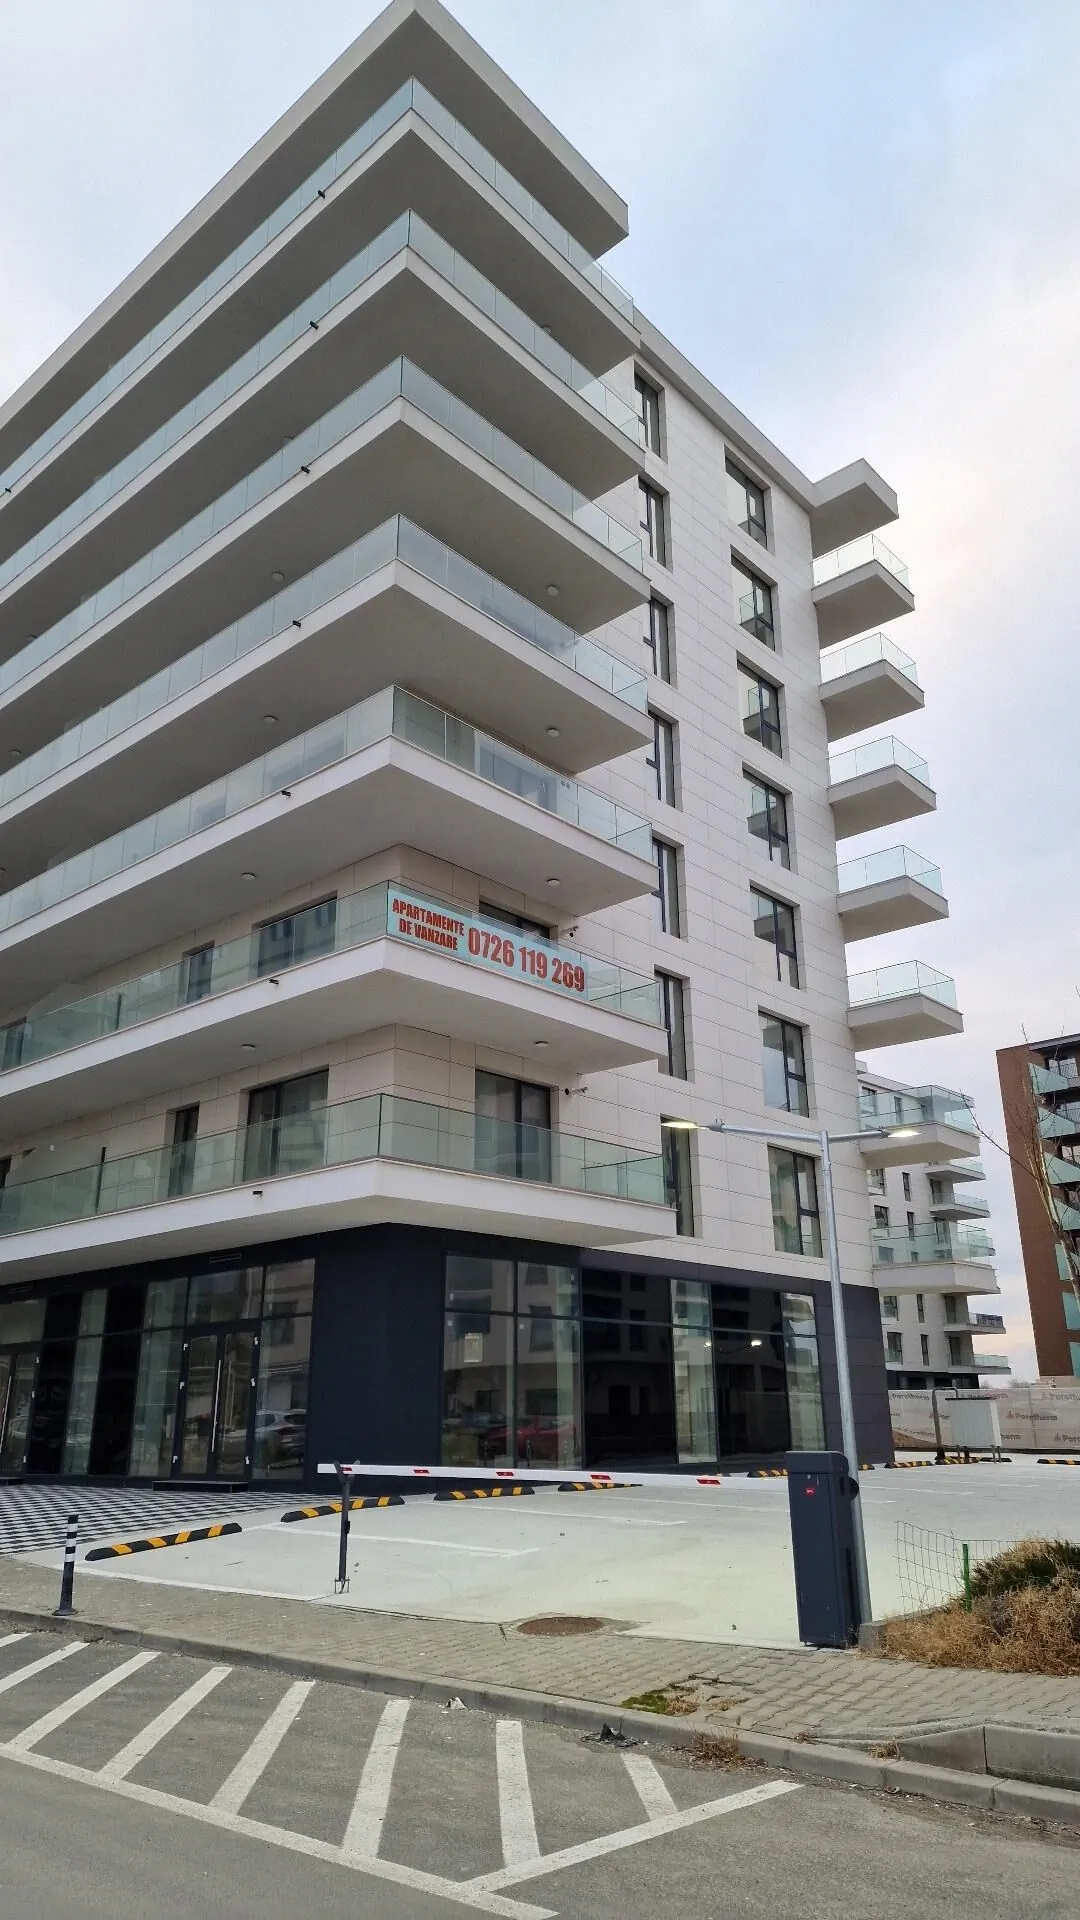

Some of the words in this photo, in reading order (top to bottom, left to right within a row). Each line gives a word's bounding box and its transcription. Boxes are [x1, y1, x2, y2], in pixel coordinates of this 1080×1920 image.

[392, 898, 465, 936] APARTAMENTE
[399, 918, 412, 935] DE
[414, 923, 458, 951] VANZARE
[468, 926, 515, 967] 0726
[519, 946, 548, 979] 119
[552, 957, 585, 993] 269
[1015, 1412, 1058, 1421] Porotherm
